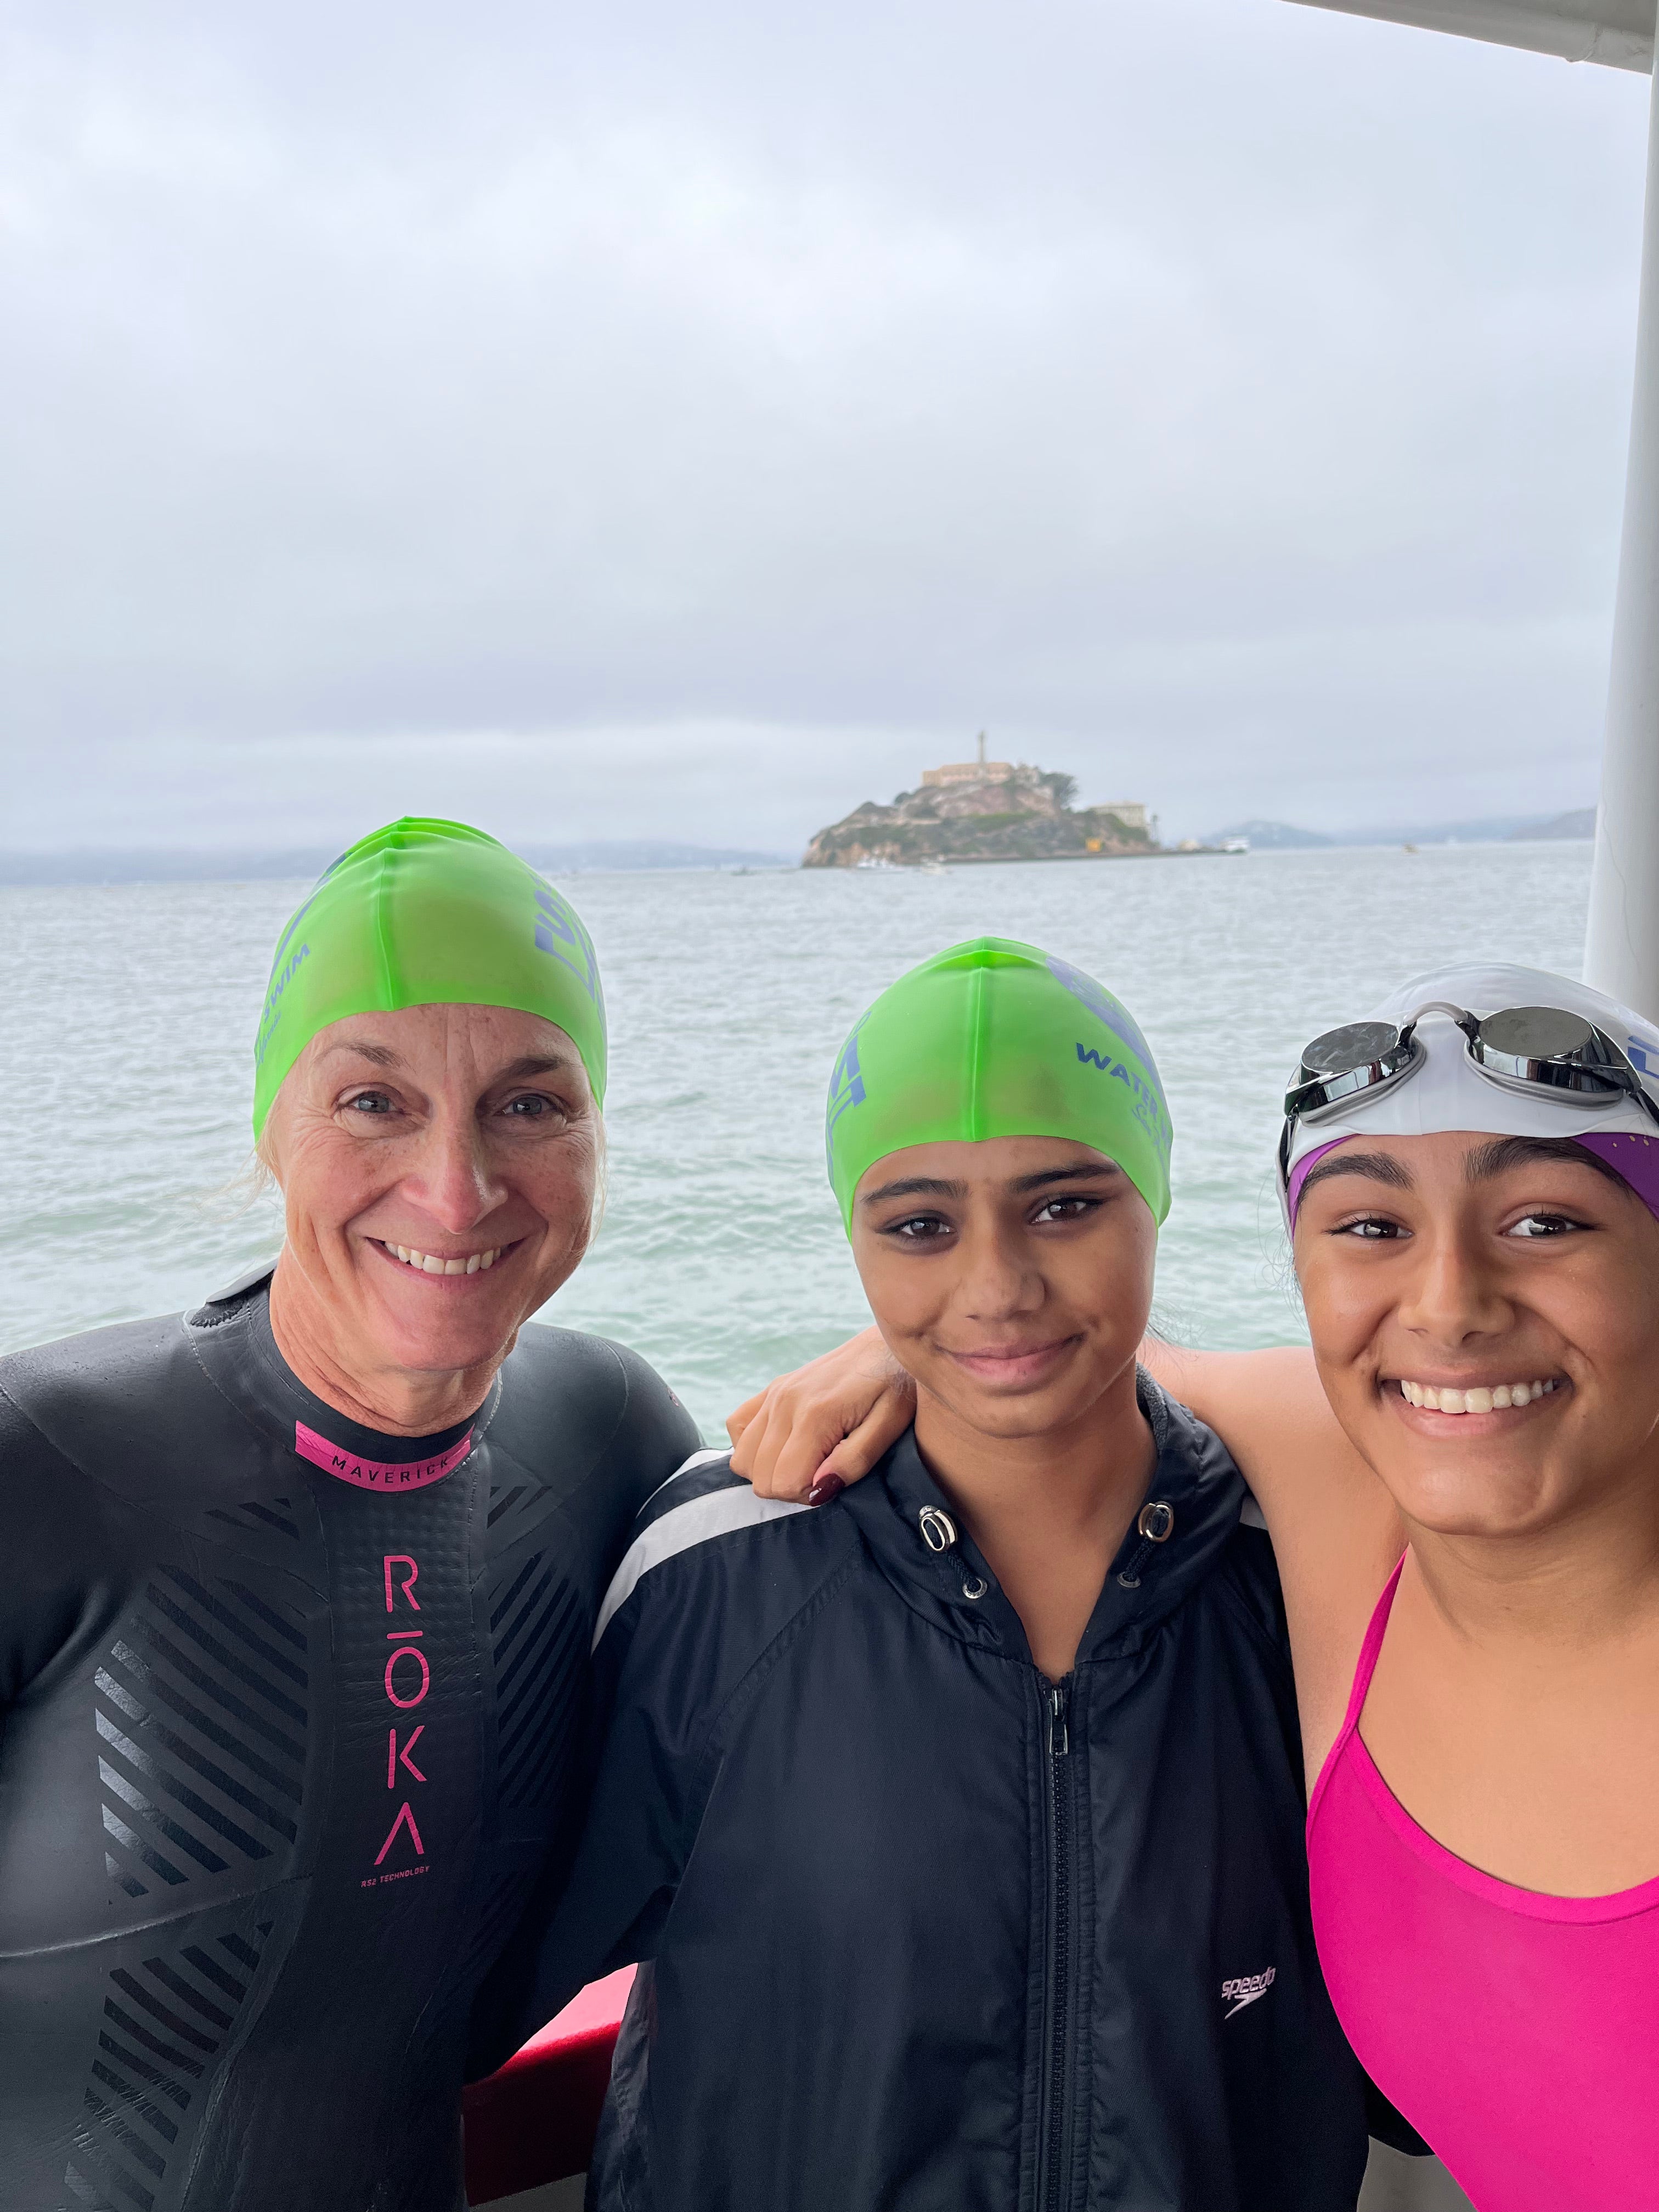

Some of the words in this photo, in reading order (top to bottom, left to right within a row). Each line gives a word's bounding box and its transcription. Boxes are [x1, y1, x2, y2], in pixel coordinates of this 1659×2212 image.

[264, 944, 311, 1024] SWIM
[332, 1455, 448, 1483] MAVERICK
[360, 1878, 376, 1887] RS2
[380, 1865, 430, 1883] TECHNOLOGY
[1221, 1966, 1276, 2000] speedo
